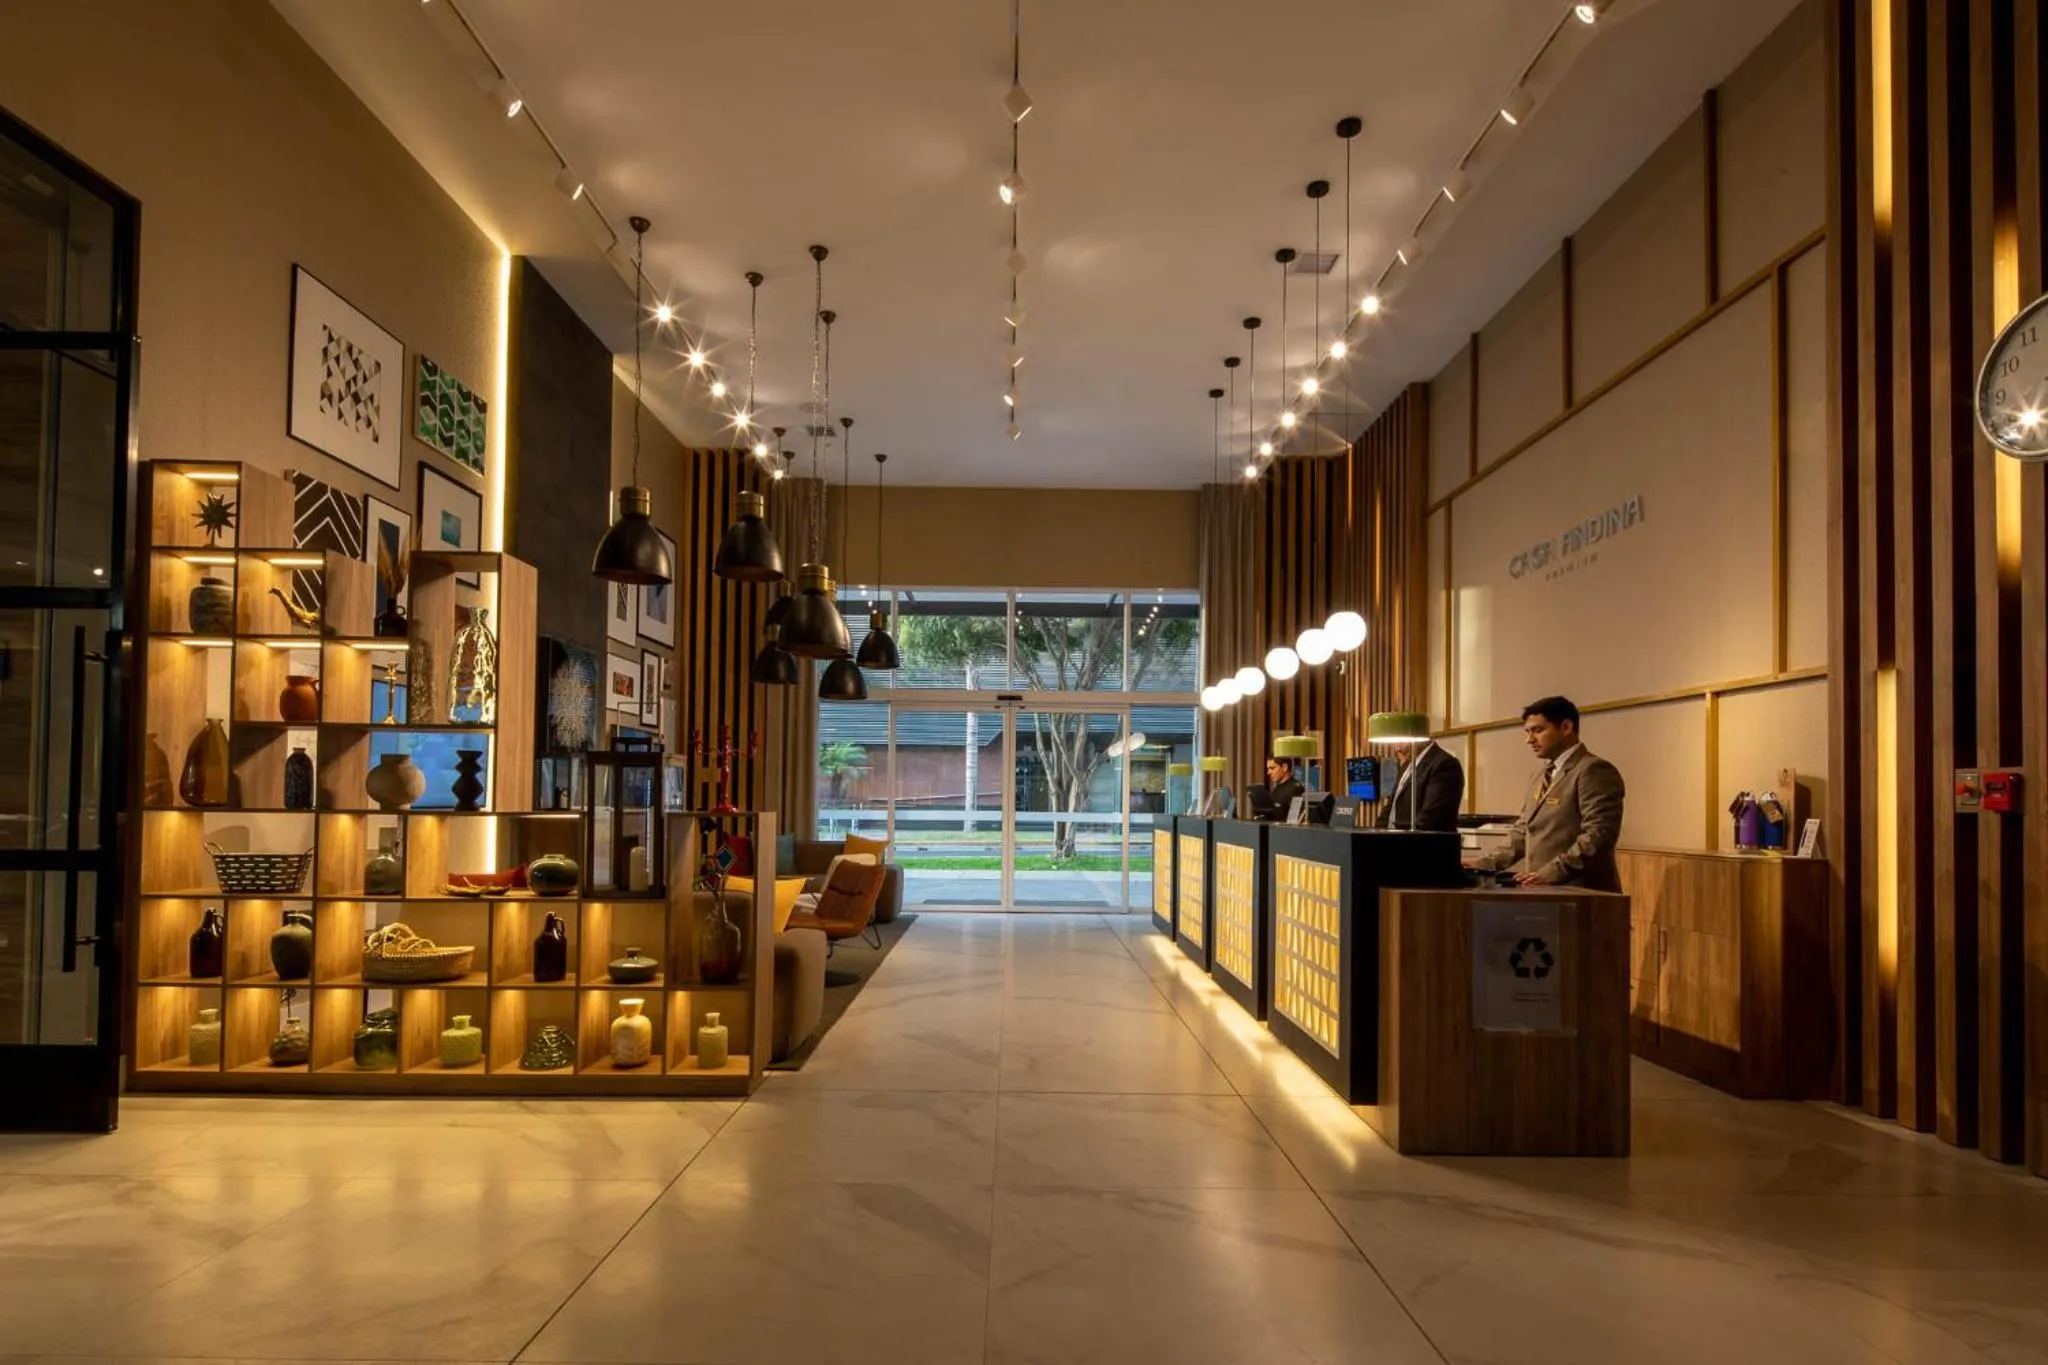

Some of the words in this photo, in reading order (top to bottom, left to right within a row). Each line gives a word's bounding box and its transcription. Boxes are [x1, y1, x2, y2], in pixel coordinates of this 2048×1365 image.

[2019, 326, 2039, 348] 11
[2000, 355, 2020, 378] 10
[1995, 388, 2007, 406] 9
[1509, 539, 1557, 580] CASA
[1561, 494, 1645, 557] ANDINA
